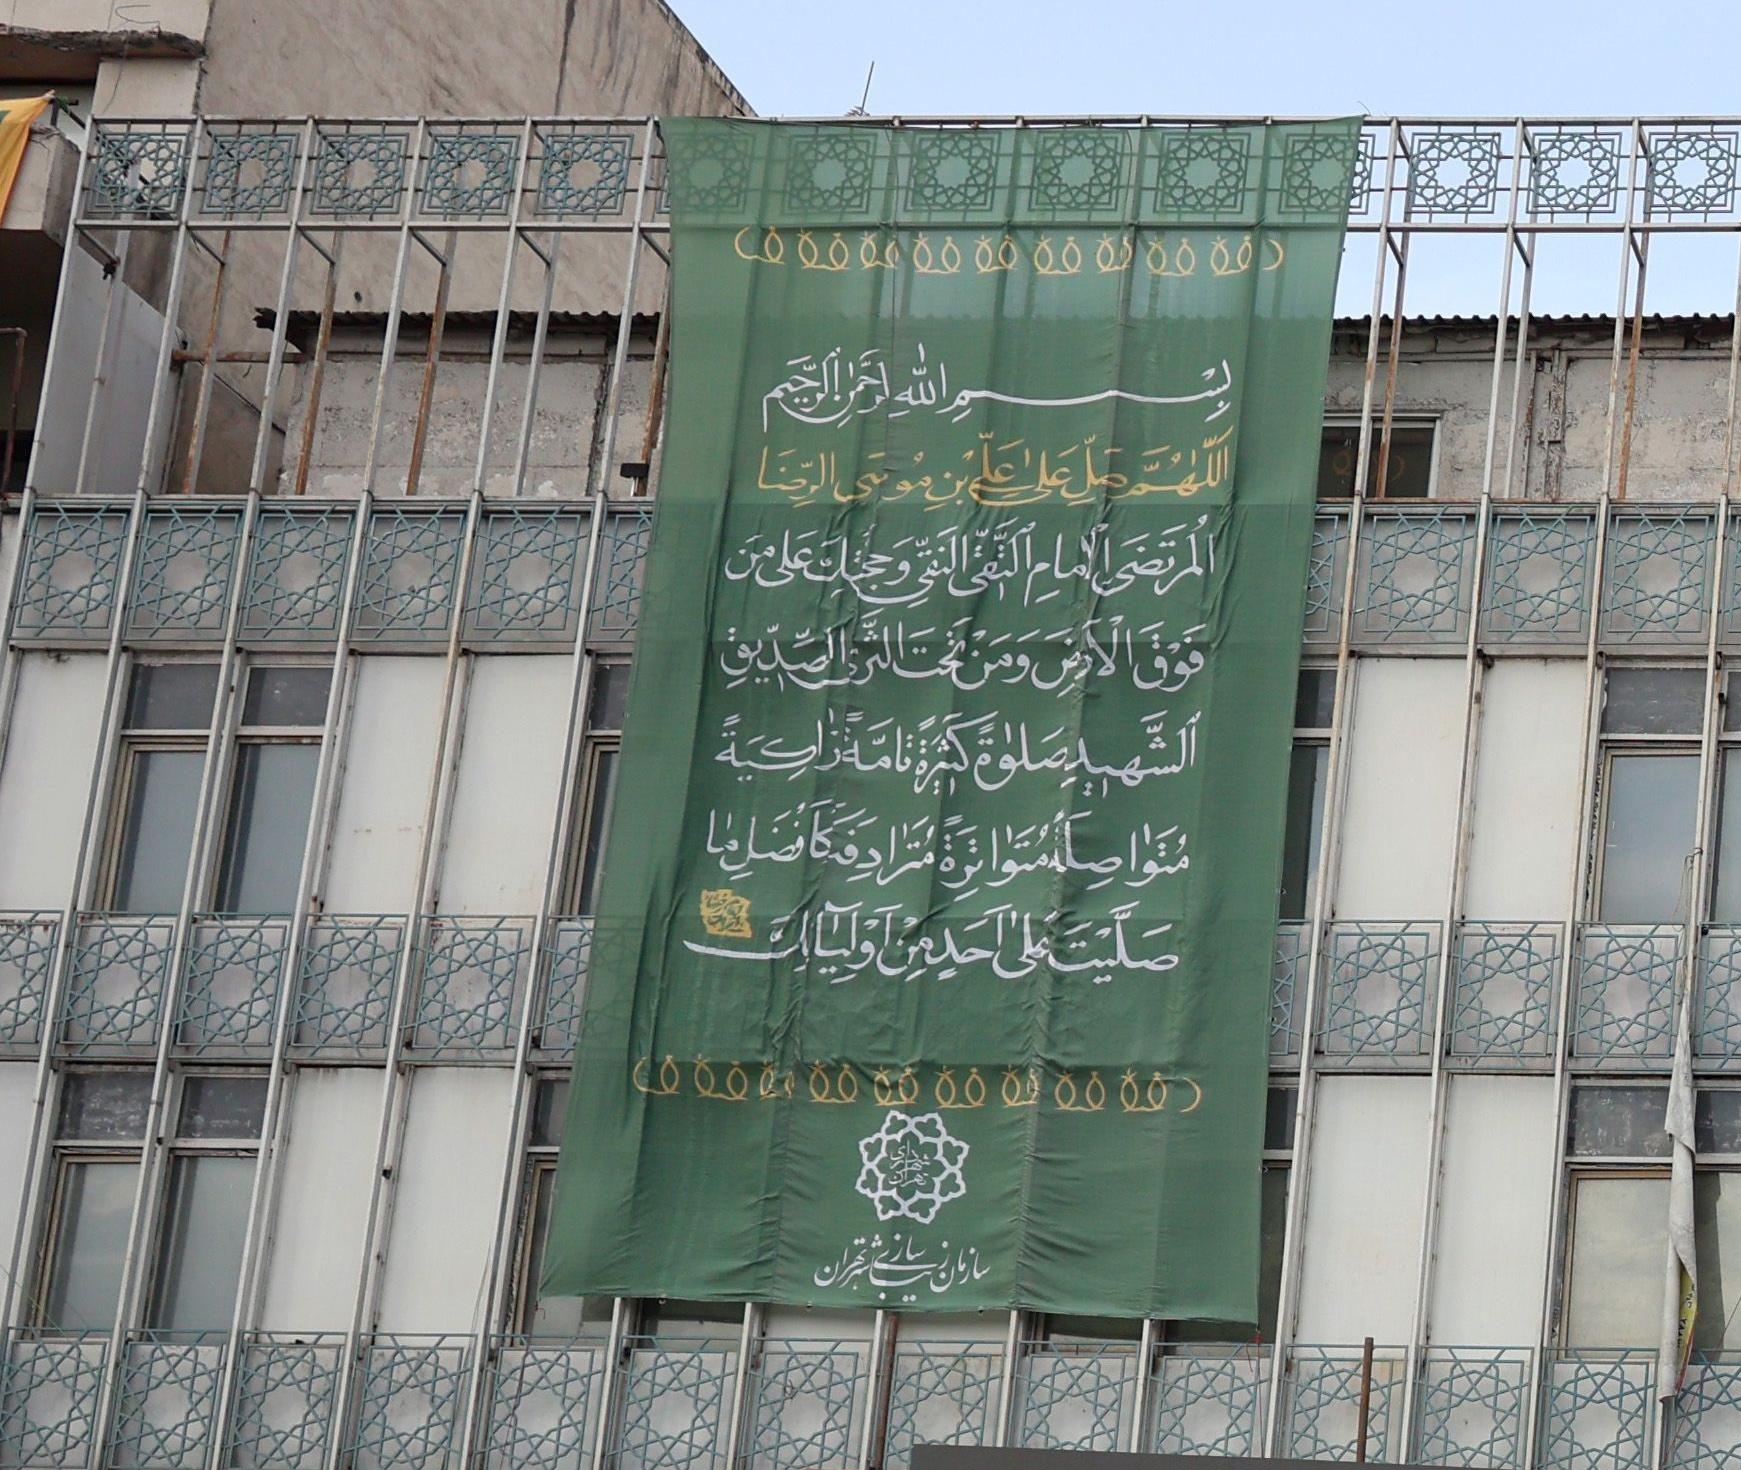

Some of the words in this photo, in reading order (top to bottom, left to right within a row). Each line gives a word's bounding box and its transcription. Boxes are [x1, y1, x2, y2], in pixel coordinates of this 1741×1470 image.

[778, 348, 889, 429] الرحمن
[888, 342, 946, 418] الله
[935, 358, 1231, 424] بسم
[1132, 623, 1208, 692] فوق
